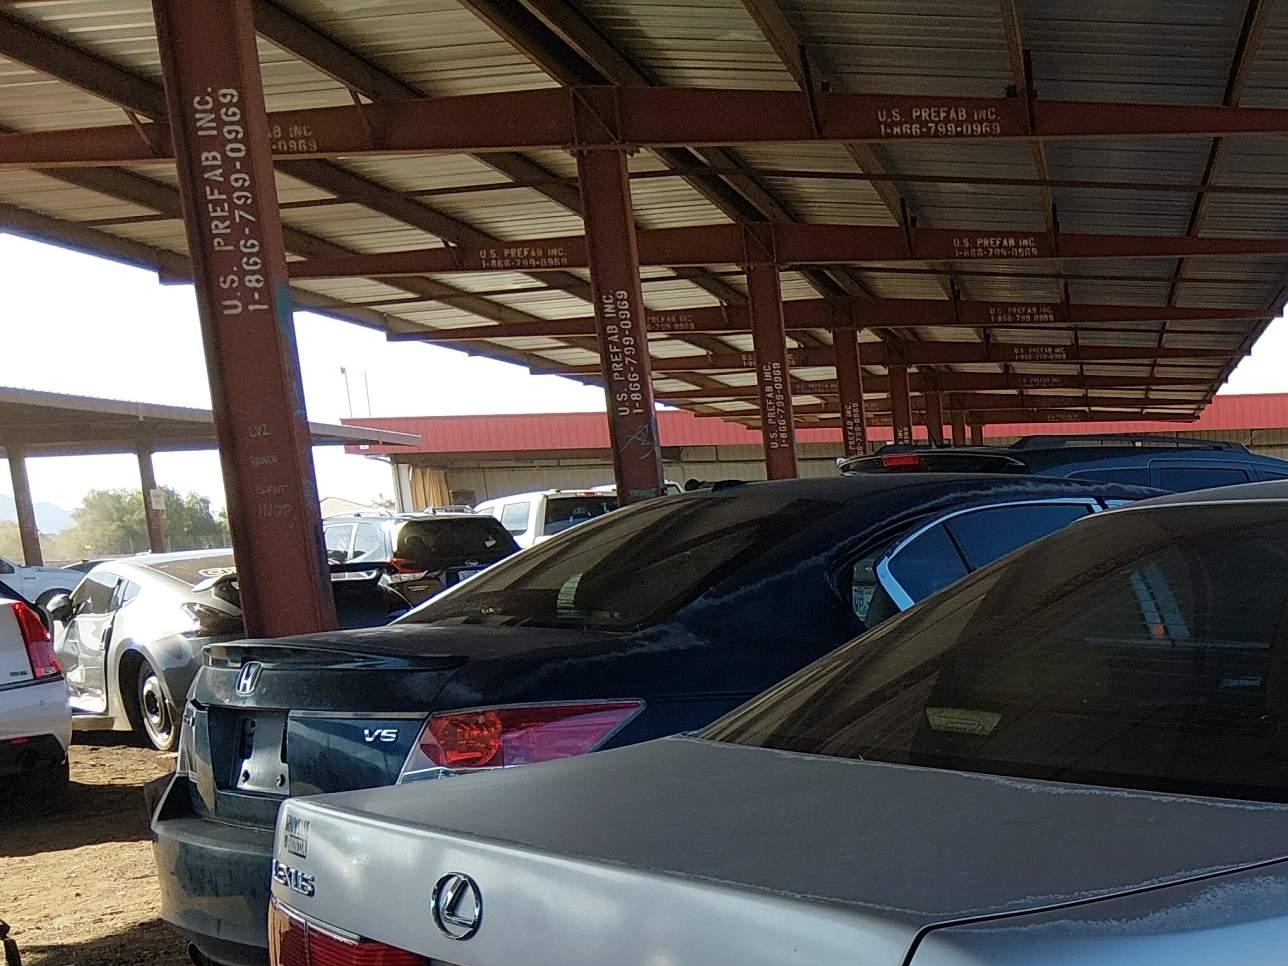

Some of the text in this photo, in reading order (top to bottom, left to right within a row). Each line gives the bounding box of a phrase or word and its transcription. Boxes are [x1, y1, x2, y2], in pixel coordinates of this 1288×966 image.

[878, 107, 905, 122] U.S.
[912, 107, 967, 121] PREFAB
[193, 87, 244, 316] U.S. PREFAB INC.
[218, 88, 269, 312] 1-866-799-0969
[504, 247, 543, 258] PREFAB
[606, 325, 625, 381] PREFAB
[616, 290, 644, 414] 1-866-799-0969
[616, 387, 630, 416] U.S.
[765, 386, 777, 425] PREFAB
